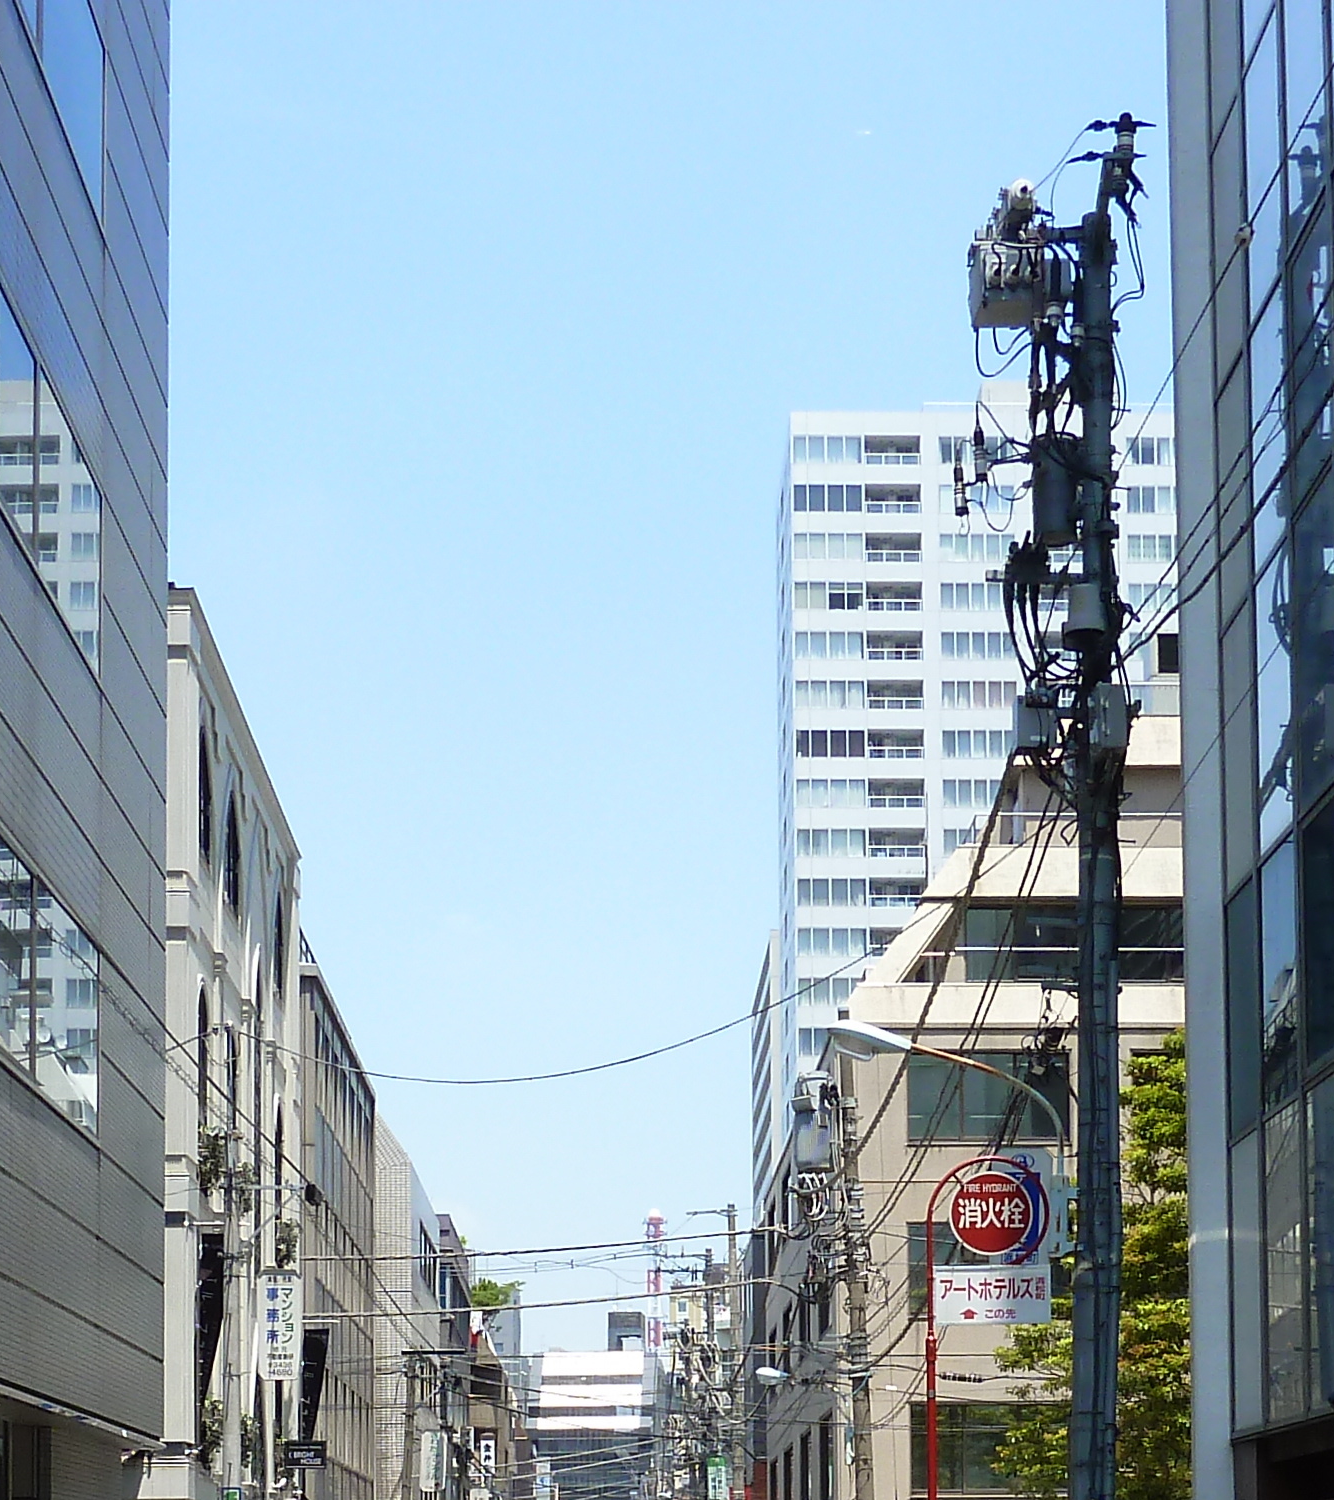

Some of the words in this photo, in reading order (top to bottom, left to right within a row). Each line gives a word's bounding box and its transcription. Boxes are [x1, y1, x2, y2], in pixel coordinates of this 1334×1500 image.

[963, 1183, 981, 1193] FIRE
[982, 1183, 1017, 1193] HYDRANT
[957, 1197, 1026, 1229] 消火栓
[939, 1277, 1034, 1301] アートホテルズ
[984, 1308, 1017, 1319] この先
